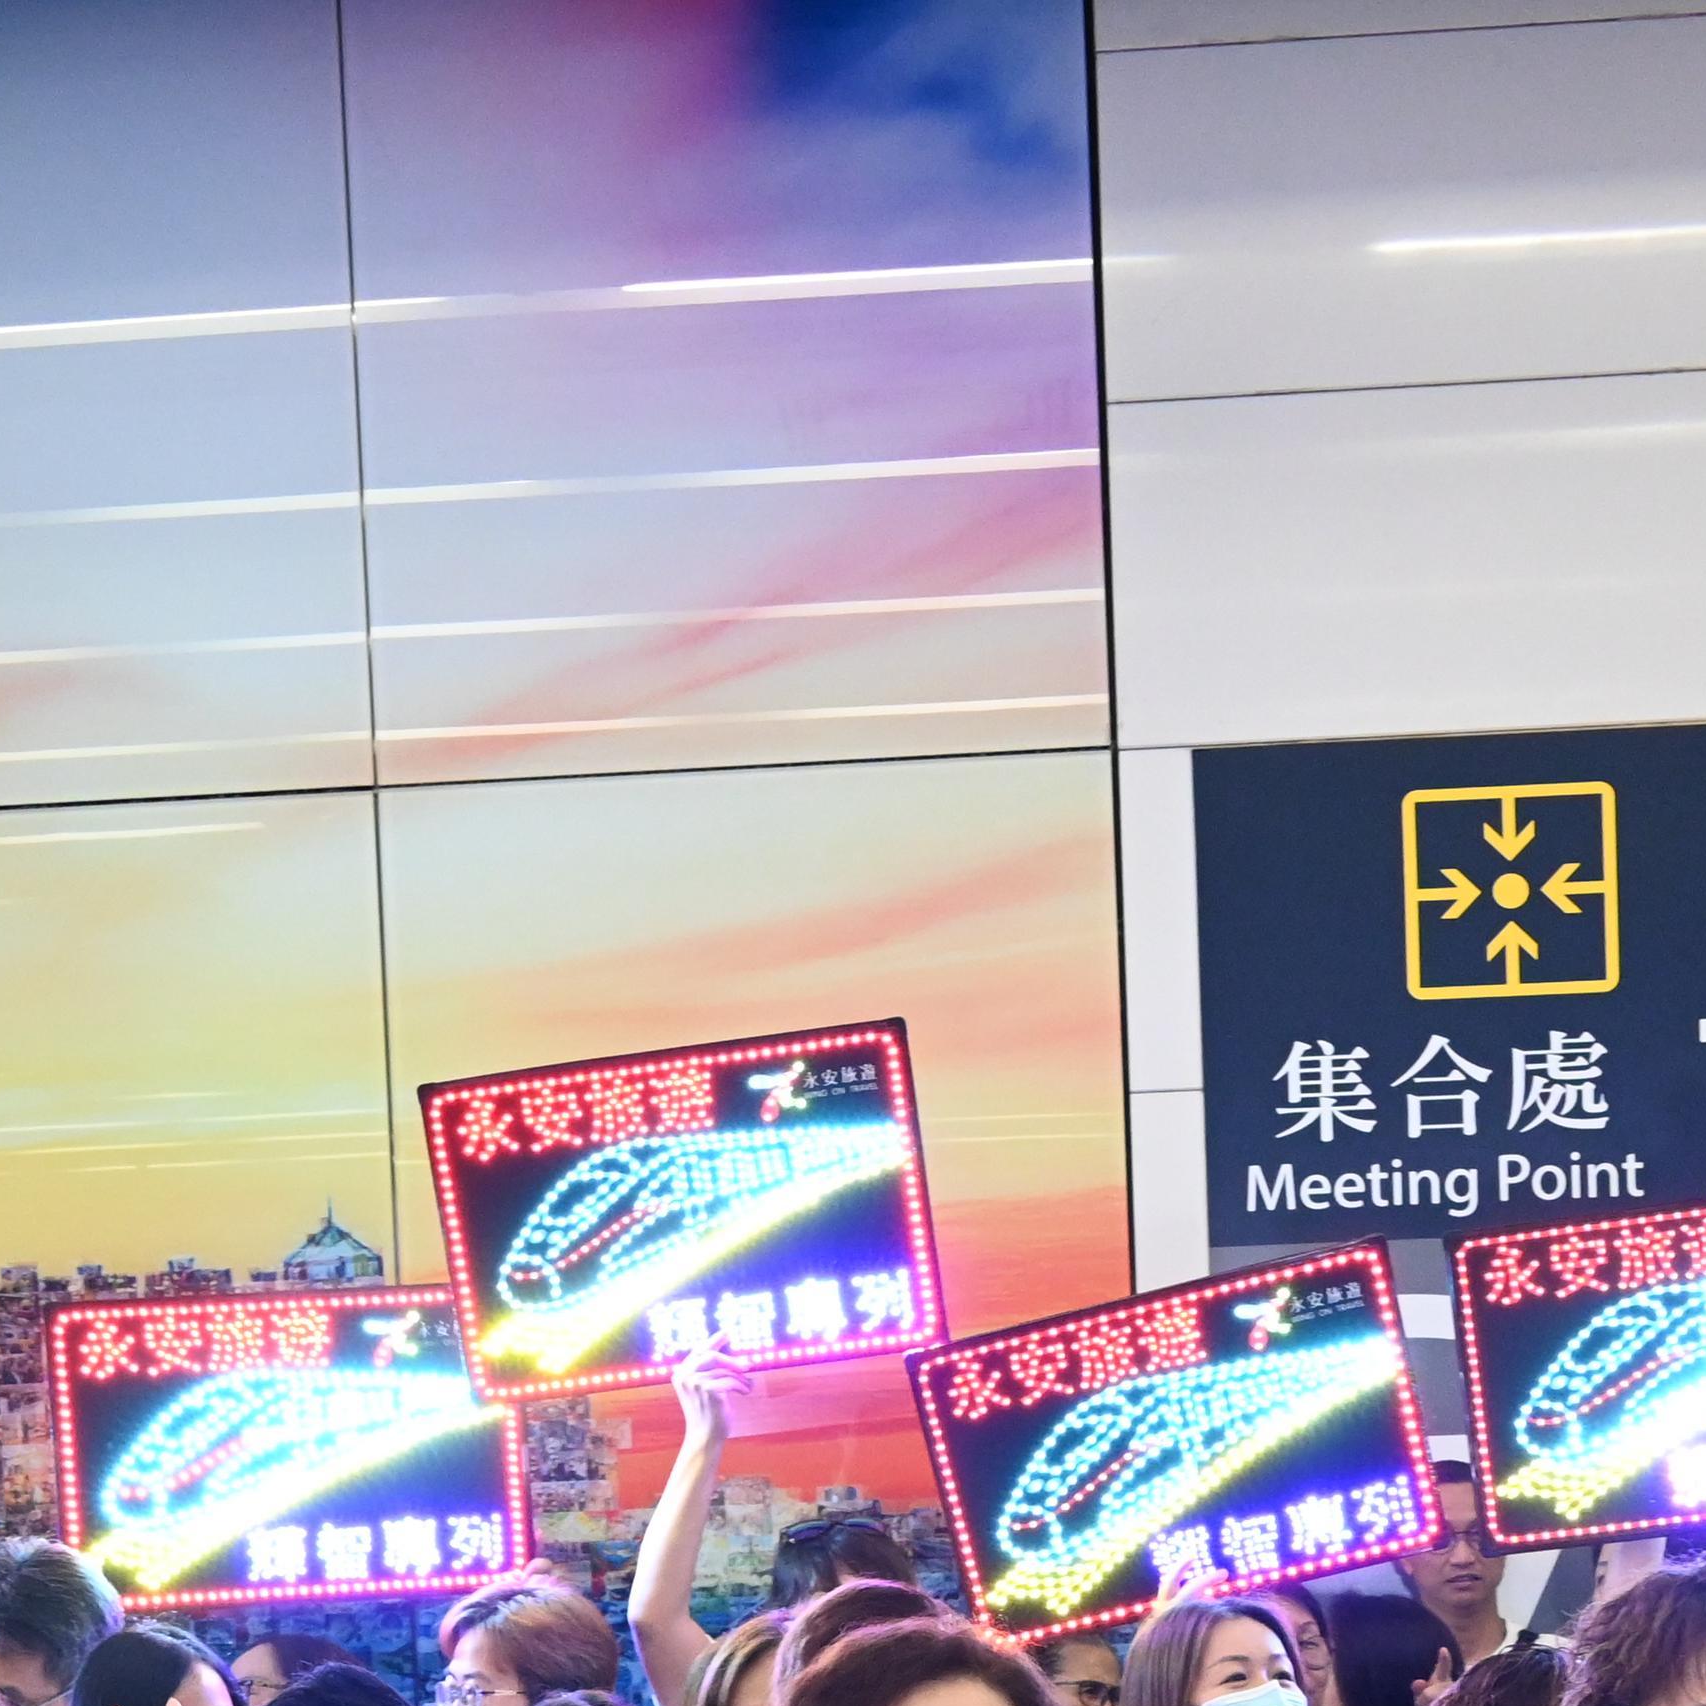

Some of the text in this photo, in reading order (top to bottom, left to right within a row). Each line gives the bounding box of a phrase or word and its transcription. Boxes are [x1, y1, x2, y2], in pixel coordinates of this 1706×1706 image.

[1272, 1030, 1610, 1143] 集合處
[1245, 1152, 1645, 1218] Meeting Point
